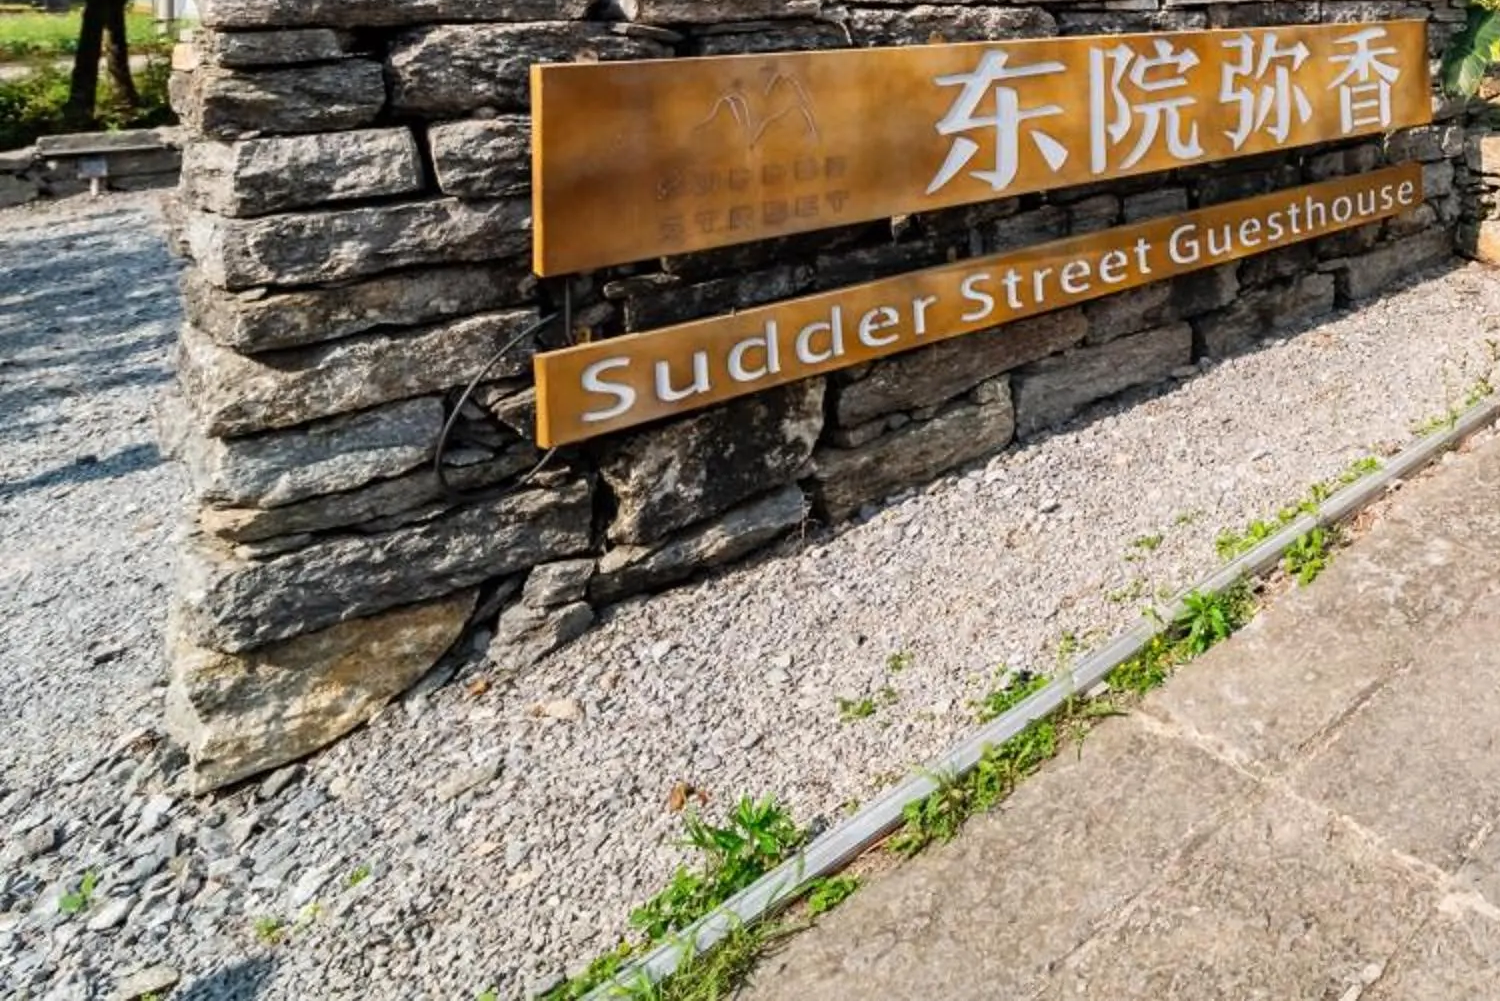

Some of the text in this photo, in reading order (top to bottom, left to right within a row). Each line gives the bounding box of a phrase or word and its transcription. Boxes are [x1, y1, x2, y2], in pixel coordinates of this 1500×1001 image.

[925, 27, 1401, 195] 东院弥香
[580, 177, 1415, 423] Sudder Street Guesthouse
